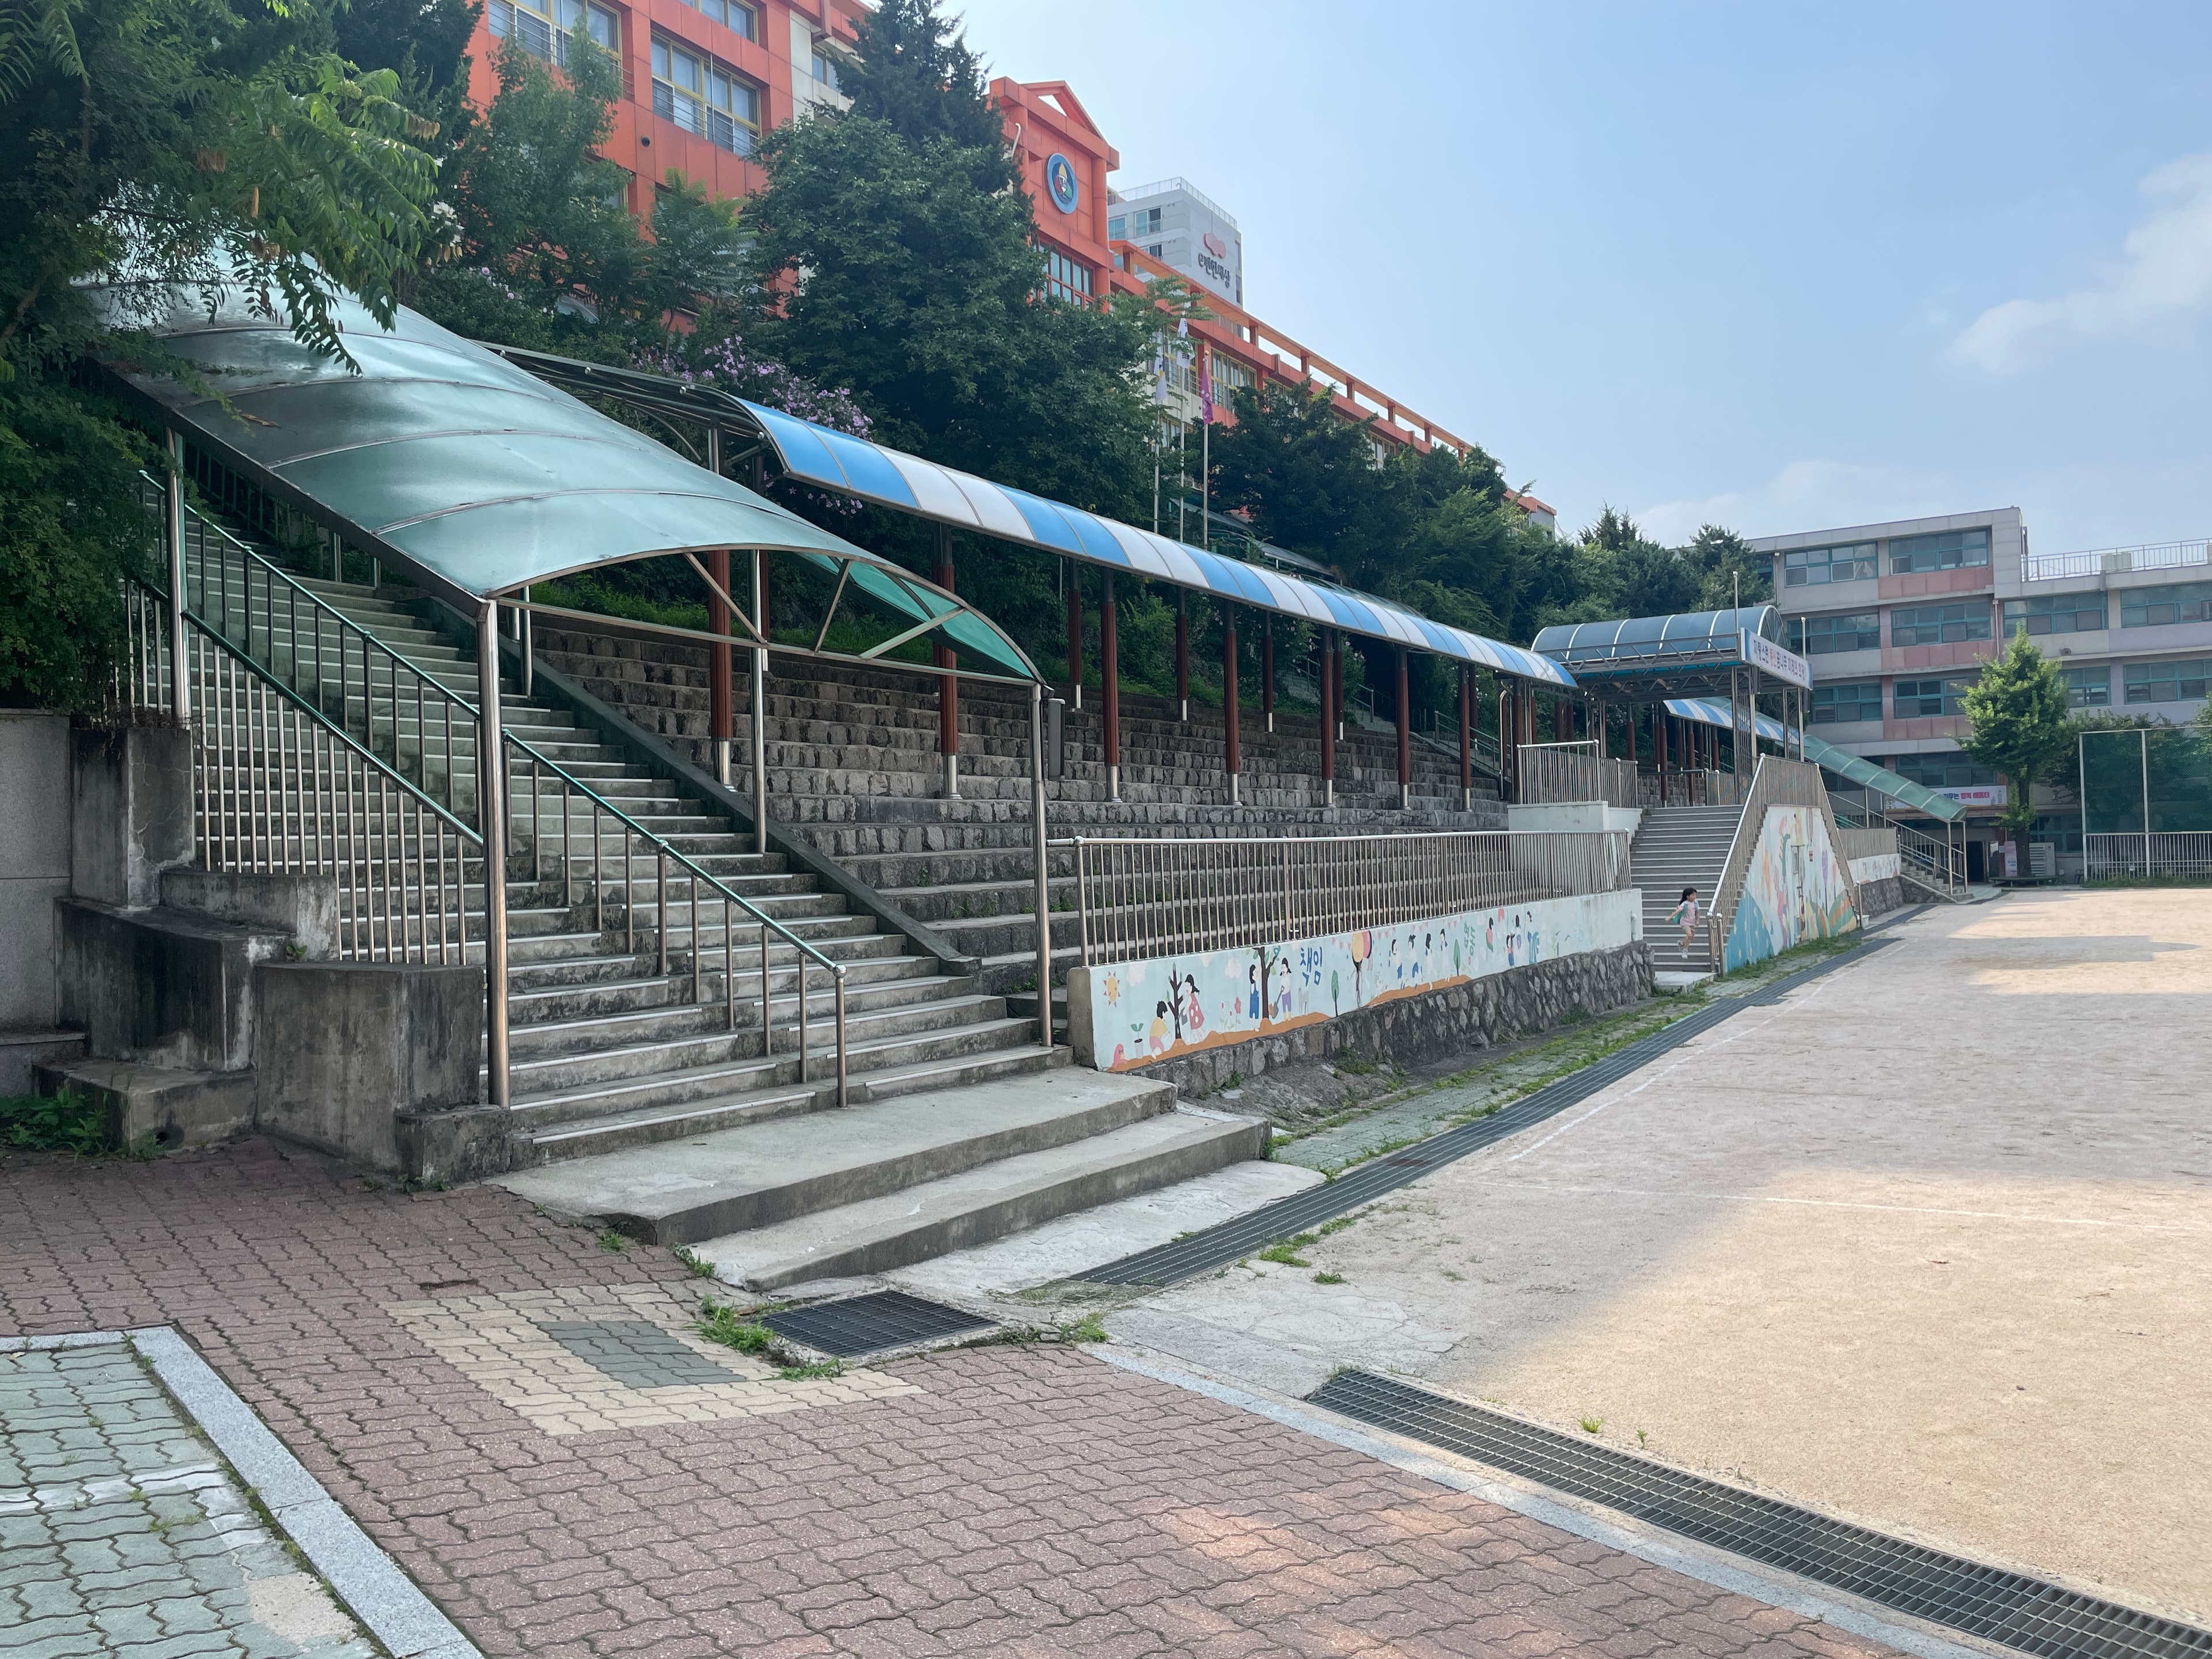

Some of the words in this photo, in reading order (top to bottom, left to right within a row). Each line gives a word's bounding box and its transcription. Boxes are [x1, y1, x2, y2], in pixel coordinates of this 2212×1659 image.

[1198, 253, 1230, 288] e편한세상
[1753, 639, 1769, 664] 자랑스런
[1464, 920, 1475, 956] 협동
[1300, 946, 1323, 987] 책임
